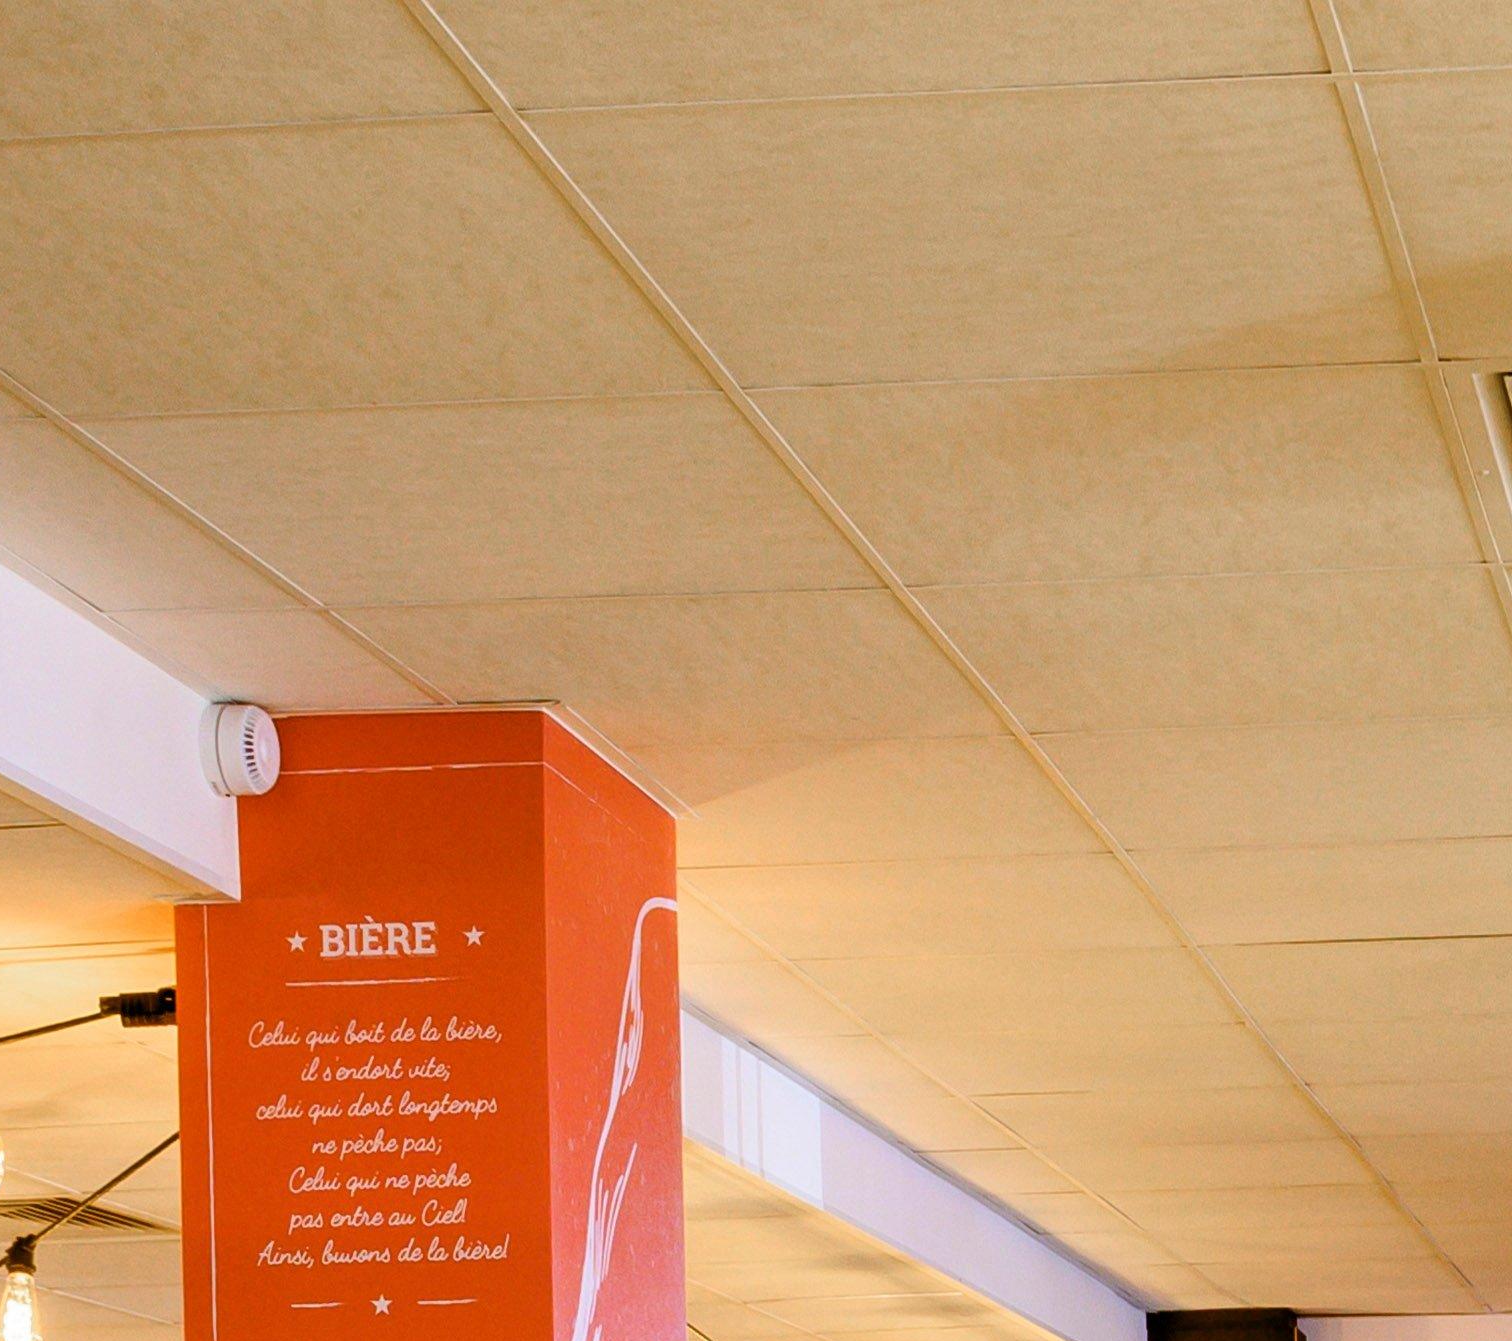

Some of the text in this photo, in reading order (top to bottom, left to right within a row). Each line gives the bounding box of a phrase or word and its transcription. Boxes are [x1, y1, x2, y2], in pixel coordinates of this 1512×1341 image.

[318, 915, 437, 958] BIÈRE
[248, 1016, 502, 1051] Celui qui boit de la bière,
[301, 1056, 450, 1082] il s'endort vite;
[256, 1091, 497, 1124] celui qui dort longtemps
[312, 1128, 442, 1160] ne pèche pas;
[289, 1163, 471, 1197] Celui qui ne pèche
[288, 1213, 323, 1235] pas
[331, 1206, 384, 1227] entre
[389, 1210, 415, 1225] au
[257, 1234, 509, 1268] Ainsi, buvons de la bière!
